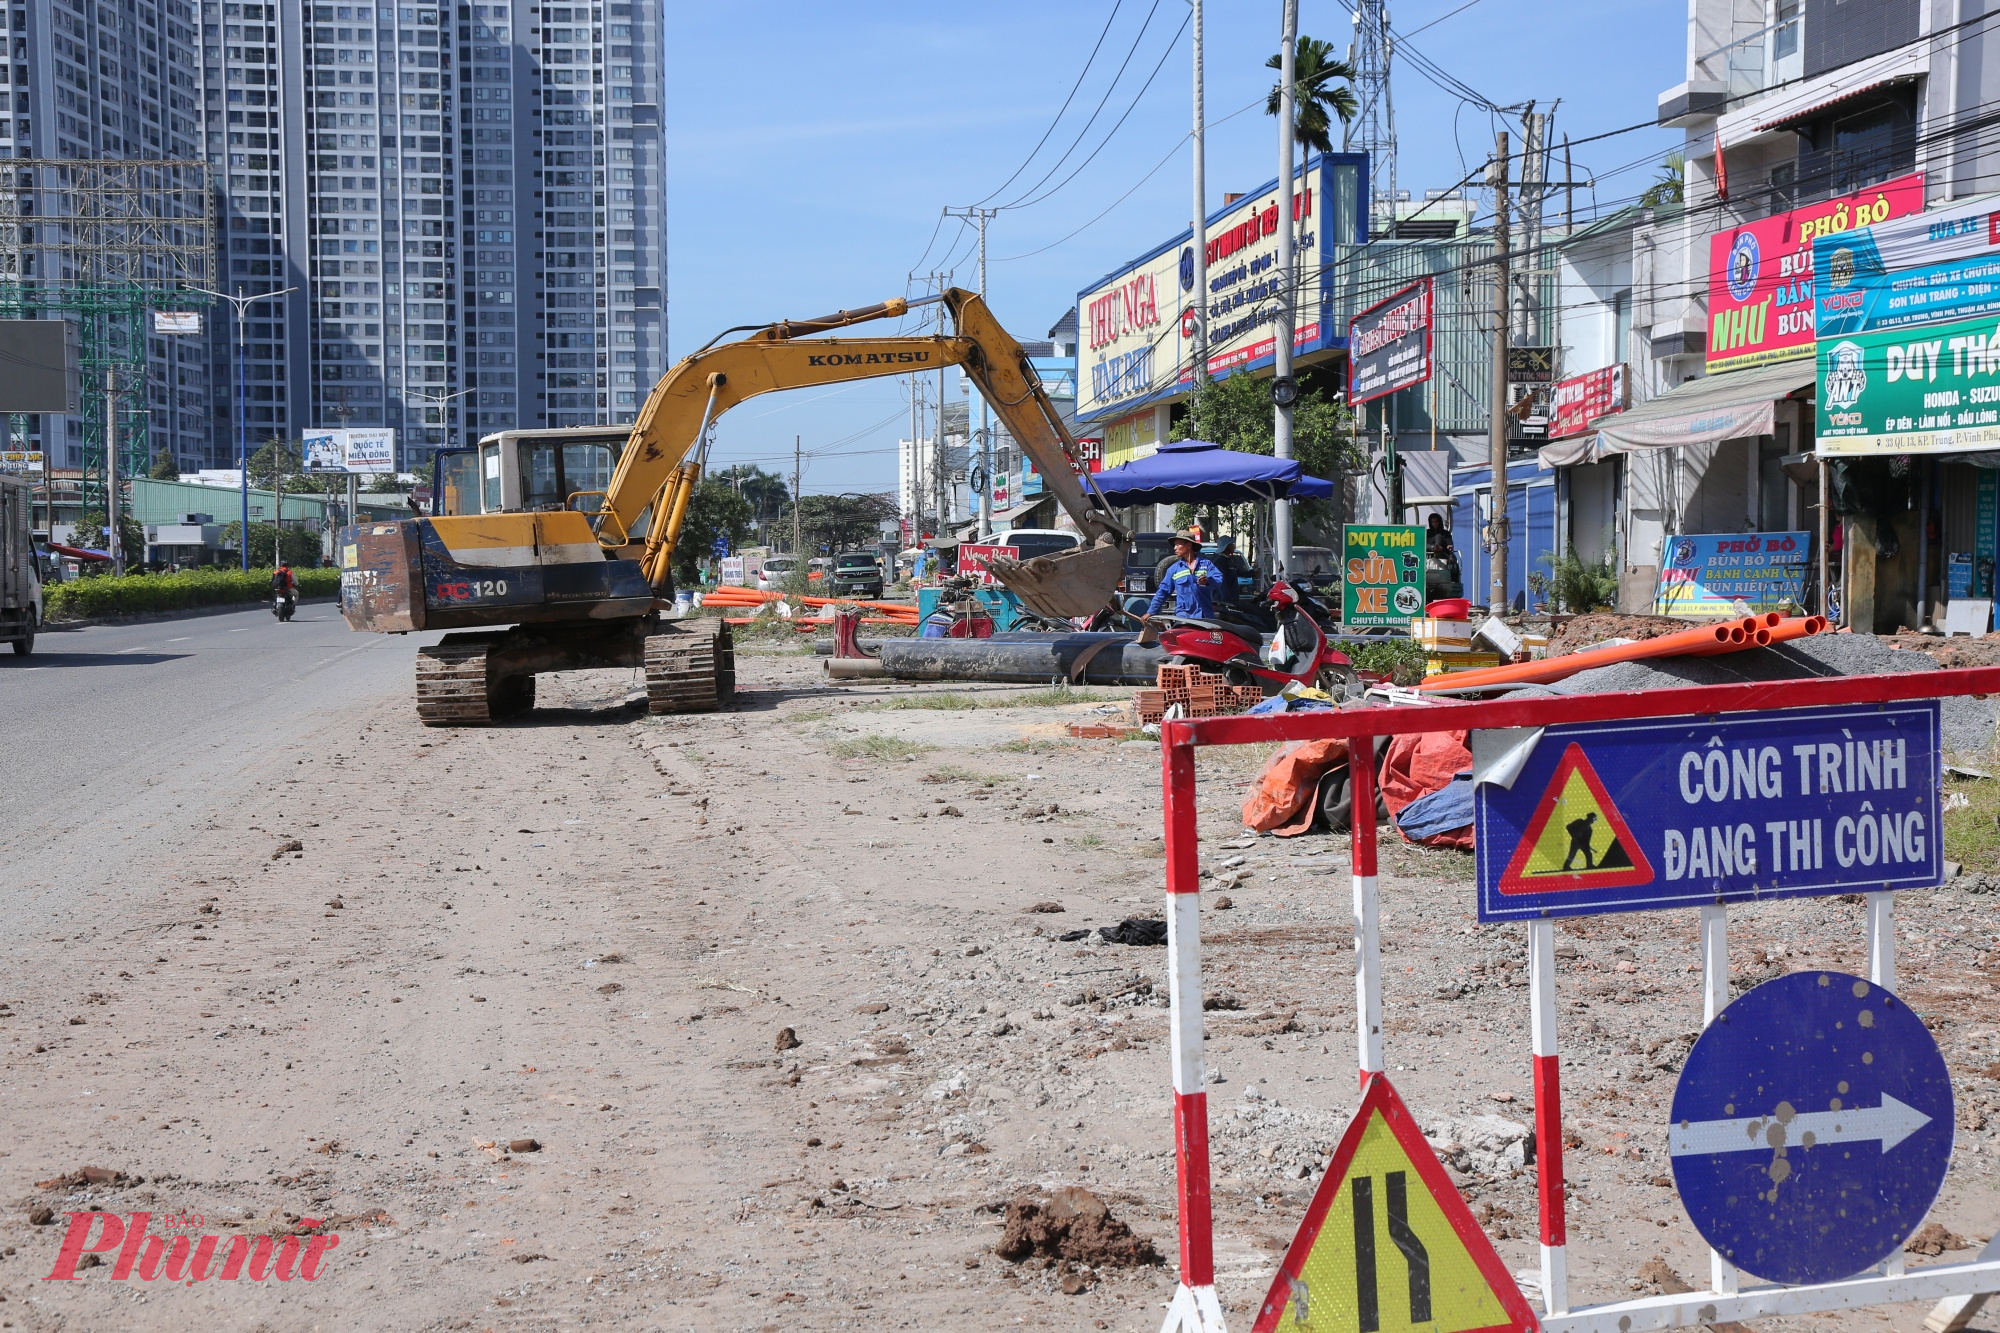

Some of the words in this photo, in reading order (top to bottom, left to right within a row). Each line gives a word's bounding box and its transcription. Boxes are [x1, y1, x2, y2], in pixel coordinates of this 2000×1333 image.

[1799, 200, 1850, 244] PHỞ
[1854, 193, 1891, 228] BÒ
[1928, 219, 1957, 241] SỬA
[1960, 216, 1978, 234] XE
[1930, 270, 1949, 286] SỬA
[1950, 267, 1961, 279] XE
[1821, 291, 1864, 312] YOKO
[1929, 289, 1959, 304] TRANG
[1967, 283, 1992, 299] ĐIỆN
[1089, 288, 1122, 352] THU
[1122, 271, 1161, 335] NGA
[1912, 313, 1930, 322] TRUNG,
[1957, 306, 1976, 316] THUẬN
[1976, 305, 1987, 313] AN,
[1711, 293, 1773, 353] NHƯ
[808, 351, 930, 367] KOMATSU
[1886, 340, 1943, 385] DUY
[1923, 390, 1960, 409] HONDA
[1828, 412, 1862, 426] YOKO
[1885, 417, 1895, 431] ÉP
[1918, 413, 1936, 429] LÀM
[353, 438, 374, 450] QUỐC
[376, 437, 384, 449] TẾ
[1885, 437, 1894, 448] 33
[1894, 437, 1906, 449] QL
[1931, 432, 1955, 449] Trung,
[1955, 431, 1963, 444] P.
[348, 449, 367, 460] MIỀN
[369, 448, 390, 459] ĐÔNG
[1347, 531, 1379, 548] DUY
[1381, 529, 1416, 548] THÁI
[1717, 535, 1762, 554] PHỞ
[1765, 535, 1797, 553] BÒ
[1347, 550, 1398, 585] SỬA
[1707, 553, 1740, 567] BÚN
[1743, 553, 1766, 566] BÒ
[1770, 550, 1804, 566] HUẾ
[1705, 567, 1741, 580] BÁNH
[1743, 567, 1781, 579] CANH
[1782, 564, 1801, 579] CÁ
[437, 582, 470, 600] PC
[473, 579, 508, 597] 120
[1703, 579, 1732, 593] BÚN
[1734, 578, 1768, 593] RIÊU
[1770, 580, 1799, 593] CUA
[1355, 587, 1389, 614] XE
[1350, 615, 1385, 625] CHUYÊN
[1678, 734, 1783, 804] CÔNG
[1792, 727, 1907, 796] TRÌNH
[1663, 825, 1756, 881] ĐANG
[1765, 818, 1823, 872] THI
[1833, 799, 1926, 868] CÔNG
